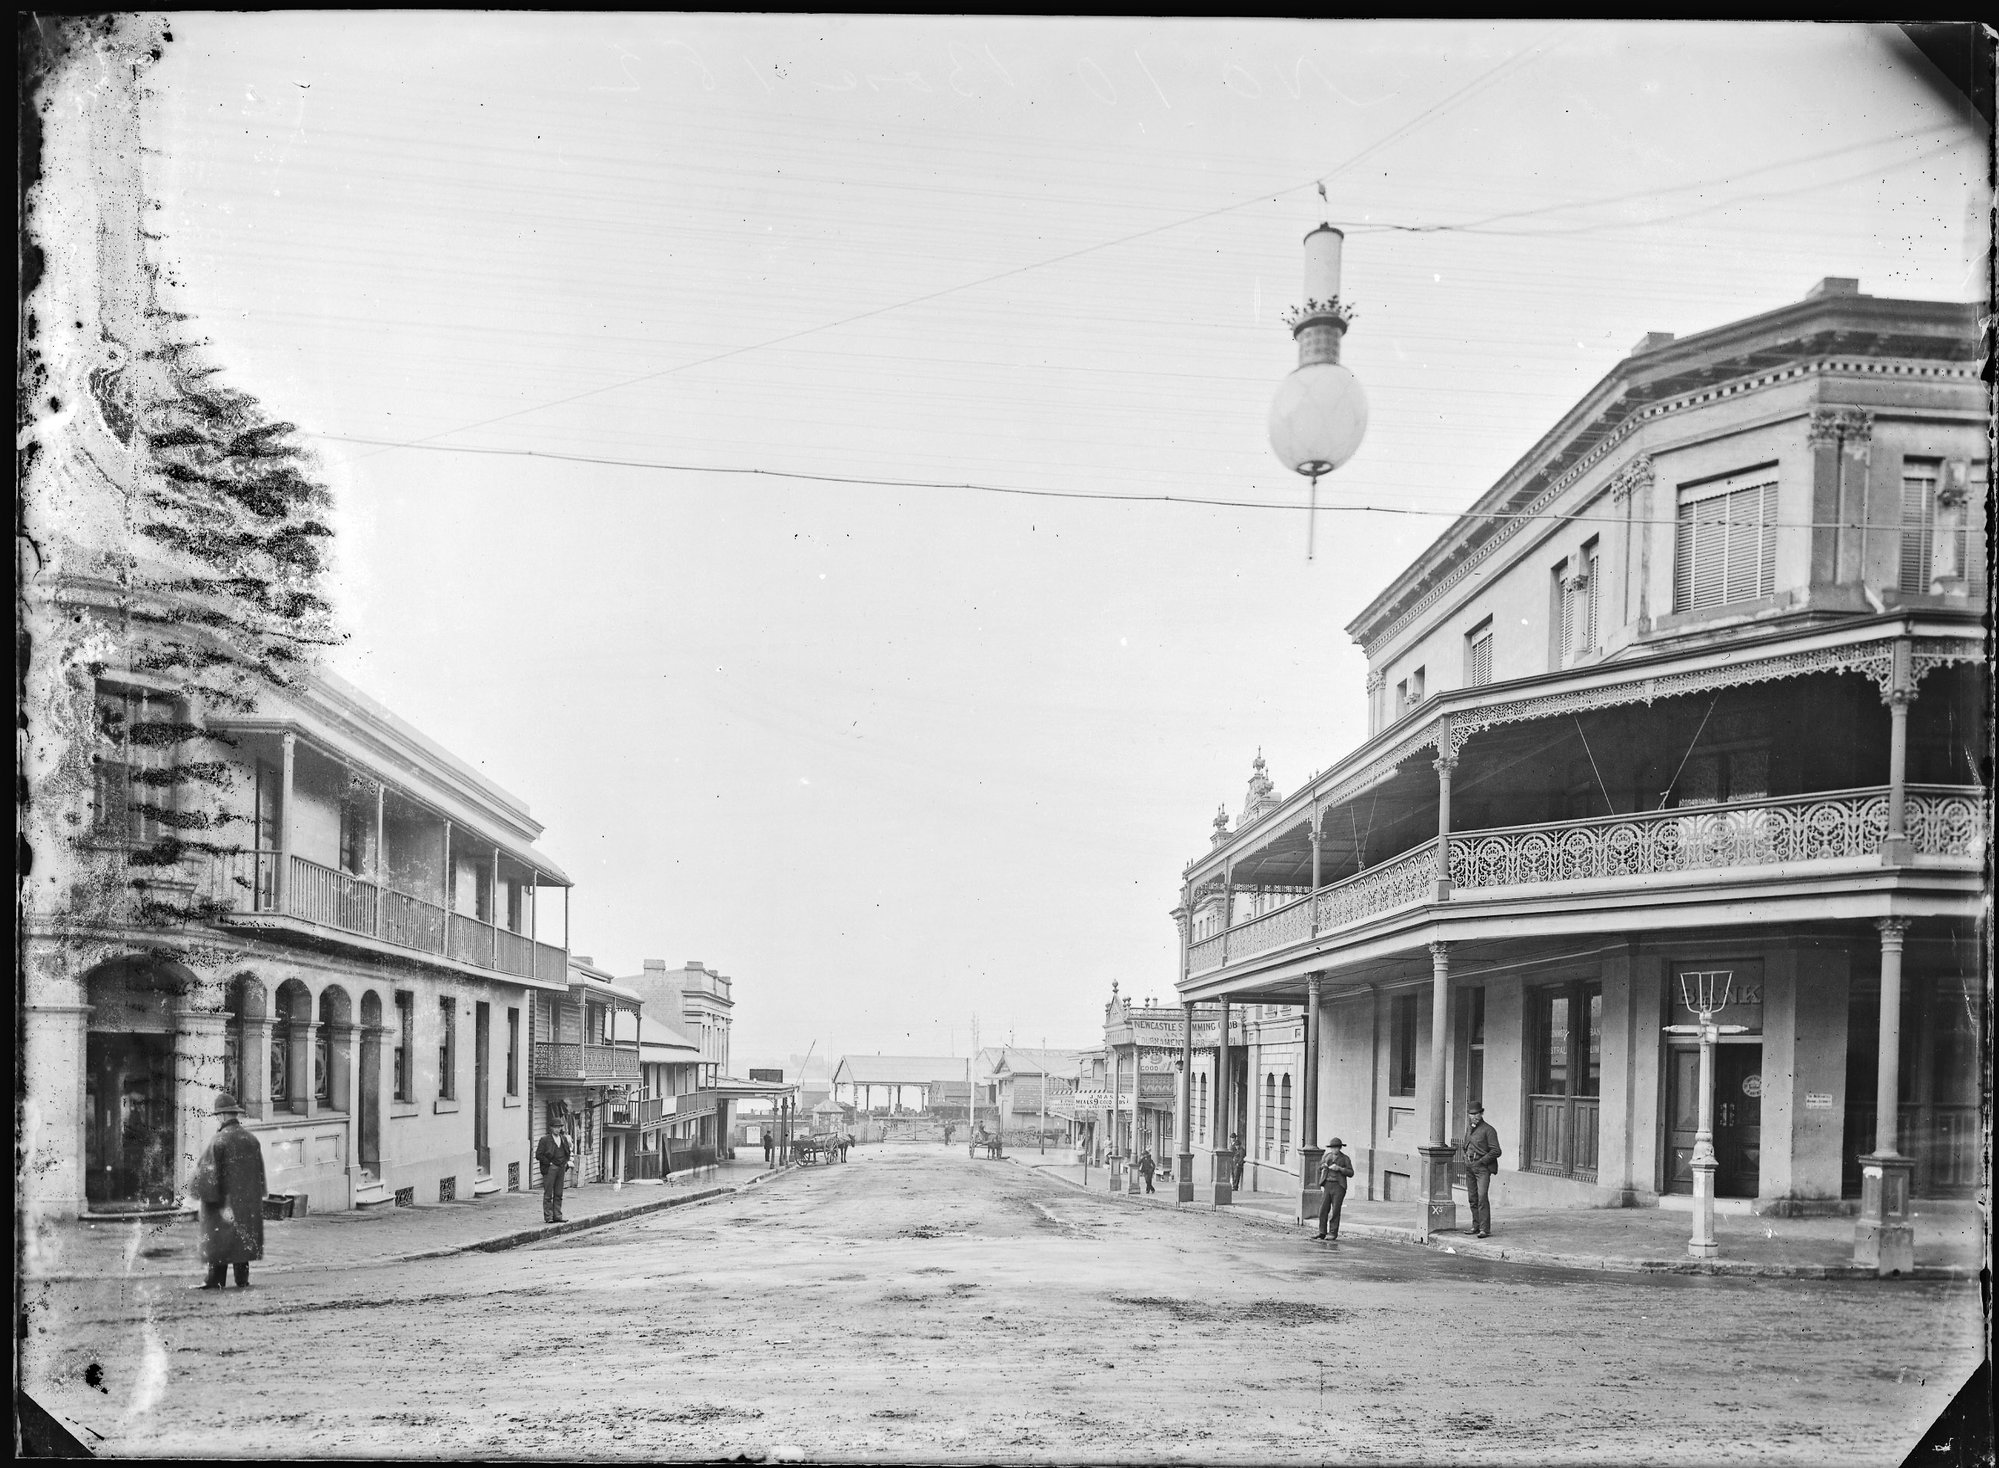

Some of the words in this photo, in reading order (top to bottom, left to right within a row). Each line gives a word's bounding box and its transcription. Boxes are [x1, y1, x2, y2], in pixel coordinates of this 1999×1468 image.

[1677, 985, 1763, 1005] BANK
[1134, 1020, 1177, 1031] NEWCASTLE
[1178, 1022, 1216, 1032] SMMING
